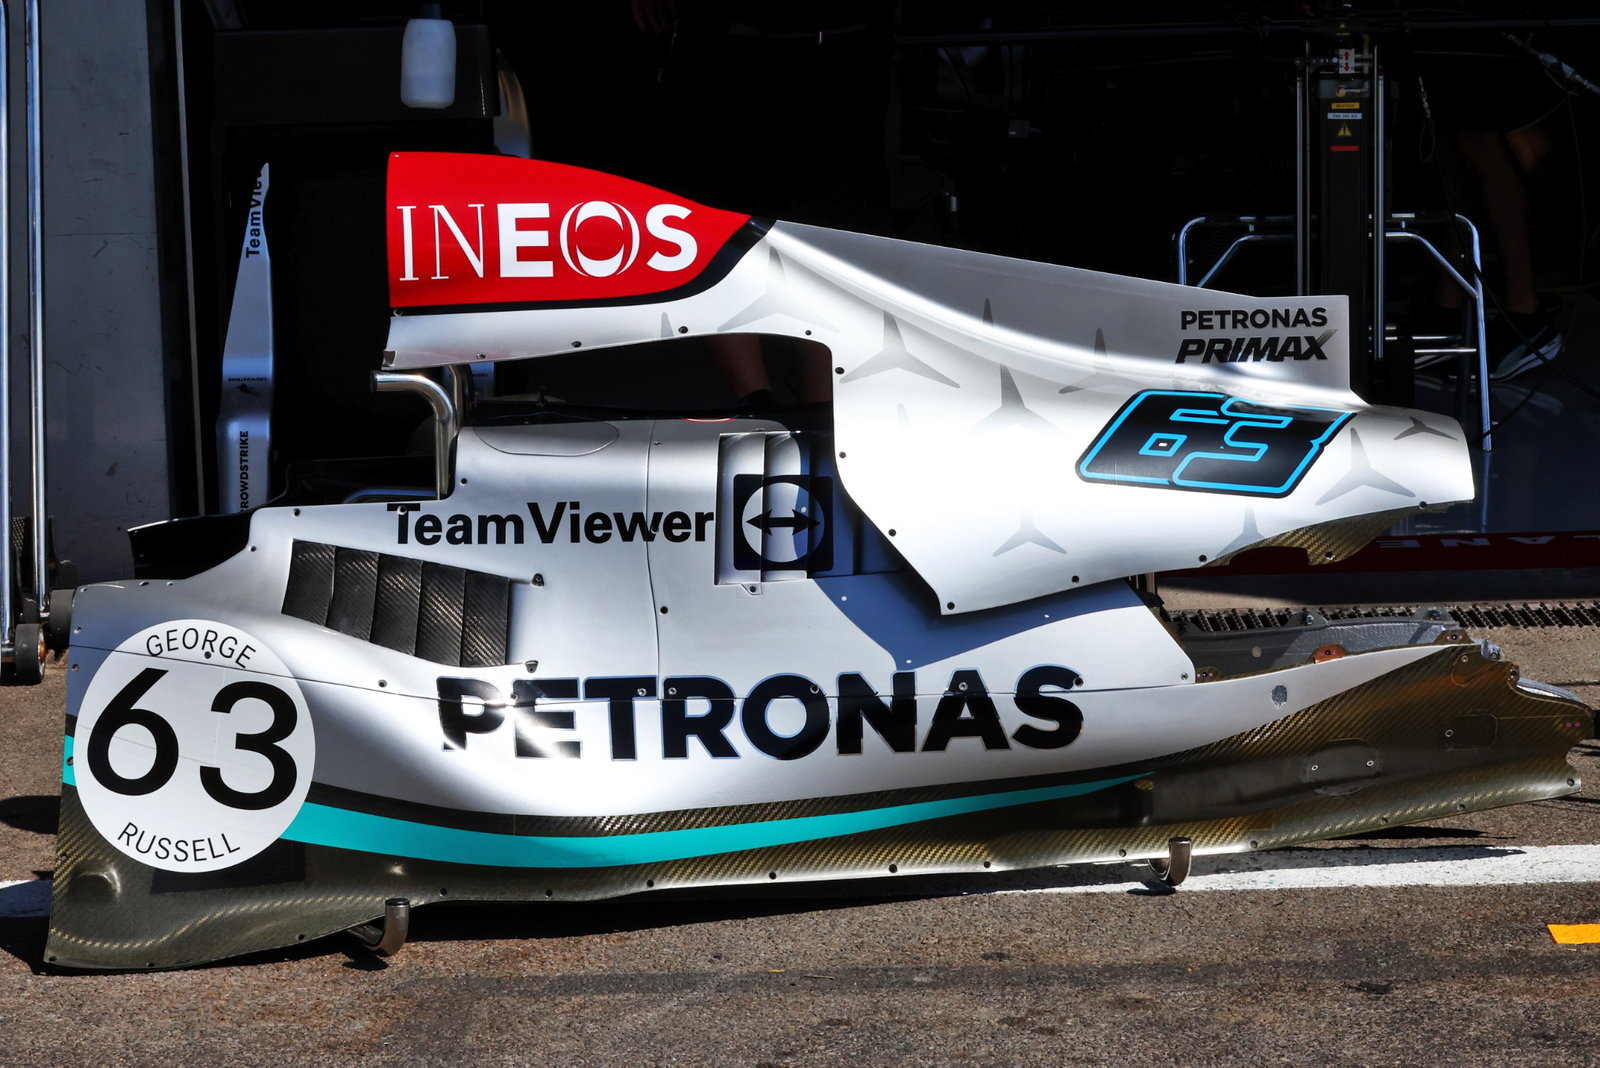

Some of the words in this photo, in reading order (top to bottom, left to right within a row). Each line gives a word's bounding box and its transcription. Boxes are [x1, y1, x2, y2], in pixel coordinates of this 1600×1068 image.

[246, 170, 262, 258] TeamVie
[396, 200, 698, 281] INEOS
[1175, 330, 1337, 364] PRIMAX
[1180, 307, 1328, 330] PETRONAS
[240, 430, 248, 512] ROWDSTRIKE
[1077, 389, 1355, 497] 63
[387, 501, 714, 545] TeamViewer
[146, 628, 256, 668] GEORGE
[87, 667, 298, 811] 63
[436, 664, 1084, 762] PETRONAS
[117, 822, 241, 862] RUSSELL
